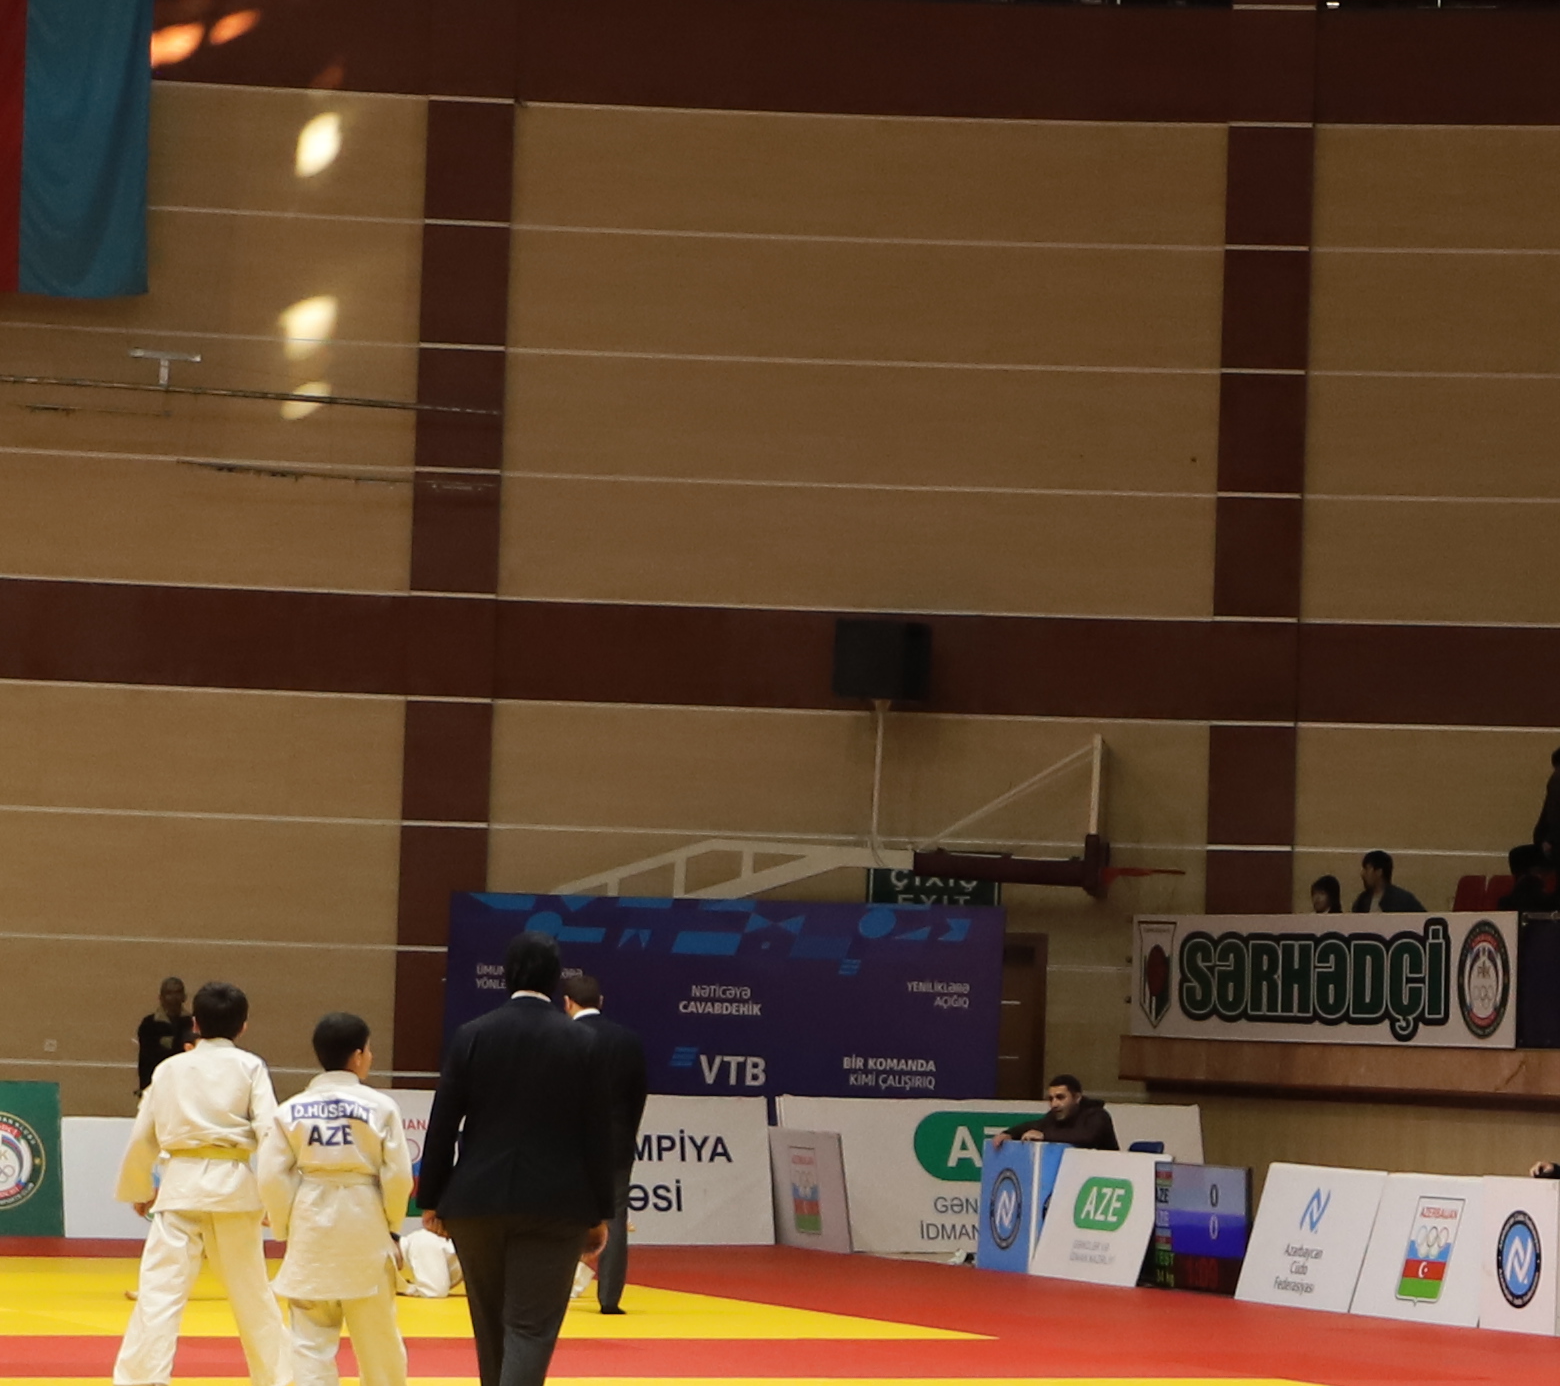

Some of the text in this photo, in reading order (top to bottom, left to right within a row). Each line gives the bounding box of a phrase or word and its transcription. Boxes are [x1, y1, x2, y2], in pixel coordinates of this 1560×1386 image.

[1180, 917, 1450, 1041] SƏRHƏDÇİ
[699, 1055, 766, 1086] VTB
[843, 1054, 936, 1072] BİR KOMANDA
[308, 1124, 354, 1146] AZE
[1081, 1185, 1125, 1223] AZE
